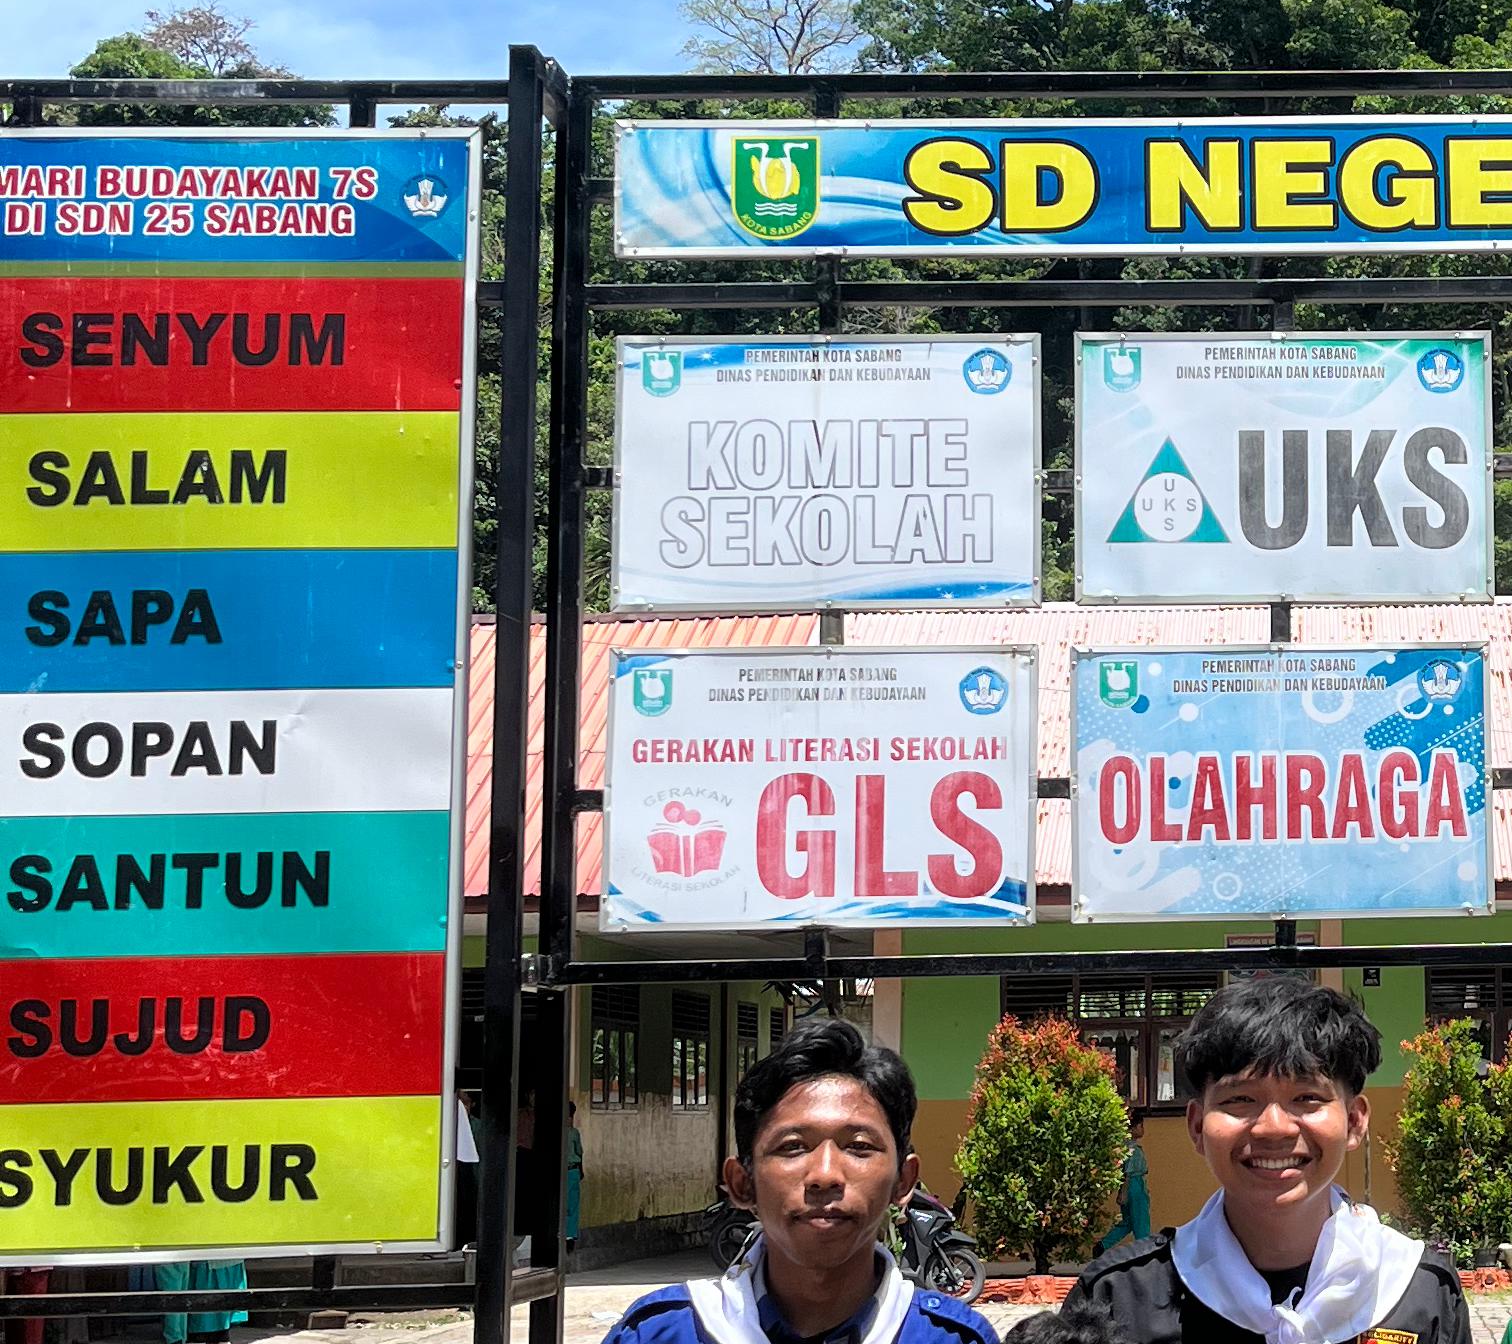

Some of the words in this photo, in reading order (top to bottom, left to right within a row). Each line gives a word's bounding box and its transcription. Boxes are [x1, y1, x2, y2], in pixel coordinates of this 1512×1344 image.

[0, 166, 85, 199] MARI
[98, 167, 317, 199] BUDAYAKAN
[333, 168, 378, 200] 7S
[903, 137, 1100, 236] SD
[5, 202, 46, 235] DI
[57, 203, 133, 235] SDN
[144, 203, 193, 235] 25
[206, 203, 355, 236] SABANG
[741, 213, 767, 235] KOTA
[769, 211, 812, 235] SABANG
[20, 313, 345, 366] SENYUM
[746, 350, 820, 364] PEMERINTAH
[822, 350, 852, 363] KOTA
[855, 349, 901, 362] SABANG
[1204, 347, 1277, 361] PEMERINTAH
[1280, 347, 1309, 360] KOTA
[1311, 347, 1357, 360] SABANG
[716, 369, 752, 382] DINAS
[755, 368, 825, 382] PENDIDIKAN
[828, 368, 853, 381] DAN
[855, 368, 931, 381] KEBUDAYAAN
[1176, 366, 1212, 380] DINAS
[1214, 366, 1283, 380] PENDIDIKAN
[1286, 366, 1310, 379] DAN
[1312, 366, 1385, 379] KEBUDAYAAN
[688, 418, 968, 491] KOMITE
[27, 450, 287, 506] SALAM
[1238, 427, 1470, 550] UKS
[659, 493, 993, 569] SEKOLAH
[25, 589, 222, 646] SAPA
[739, 668, 813, 682] PEMERINTAH
[817, 668, 846, 682] KOTA
[849, 667, 897, 681] SABANG
[1173, 679, 1208, 693] DINAS
[1211, 678, 1281, 693] PENDIDIKAN
[1284, 678, 1308, 692] DAN
[1311, 677, 1385, 691] KEBUDAYAAN
[1202, 660, 1275, 674] PEMERINTAH
[1278, 659, 1307, 673] KOTA
[1310, 658, 1356, 672] SABANG
[708, 688, 745, 702] DINAS
[748, 687, 820, 702] PENDIDIKAN
[823, 687, 847, 701] DAN
[850, 687, 926, 701] KEBUDAYAAN
[20, 719, 277, 778] SOPAN
[632, 739, 754, 764] GERAKAN
[765, 738, 880, 762] LITERASI
[890, 736, 1008, 761] SEKOLAH
[643, 786, 733, 807] GERAKAN
[1099, 751, 1469, 845] OLAHRAGA
[755, 770, 1003, 900] GLS
[7, 851, 330, 913] SANTUN
[7, 996, 271, 1058] SUJUD
[0, 1143, 318, 1208] SYUKUR
